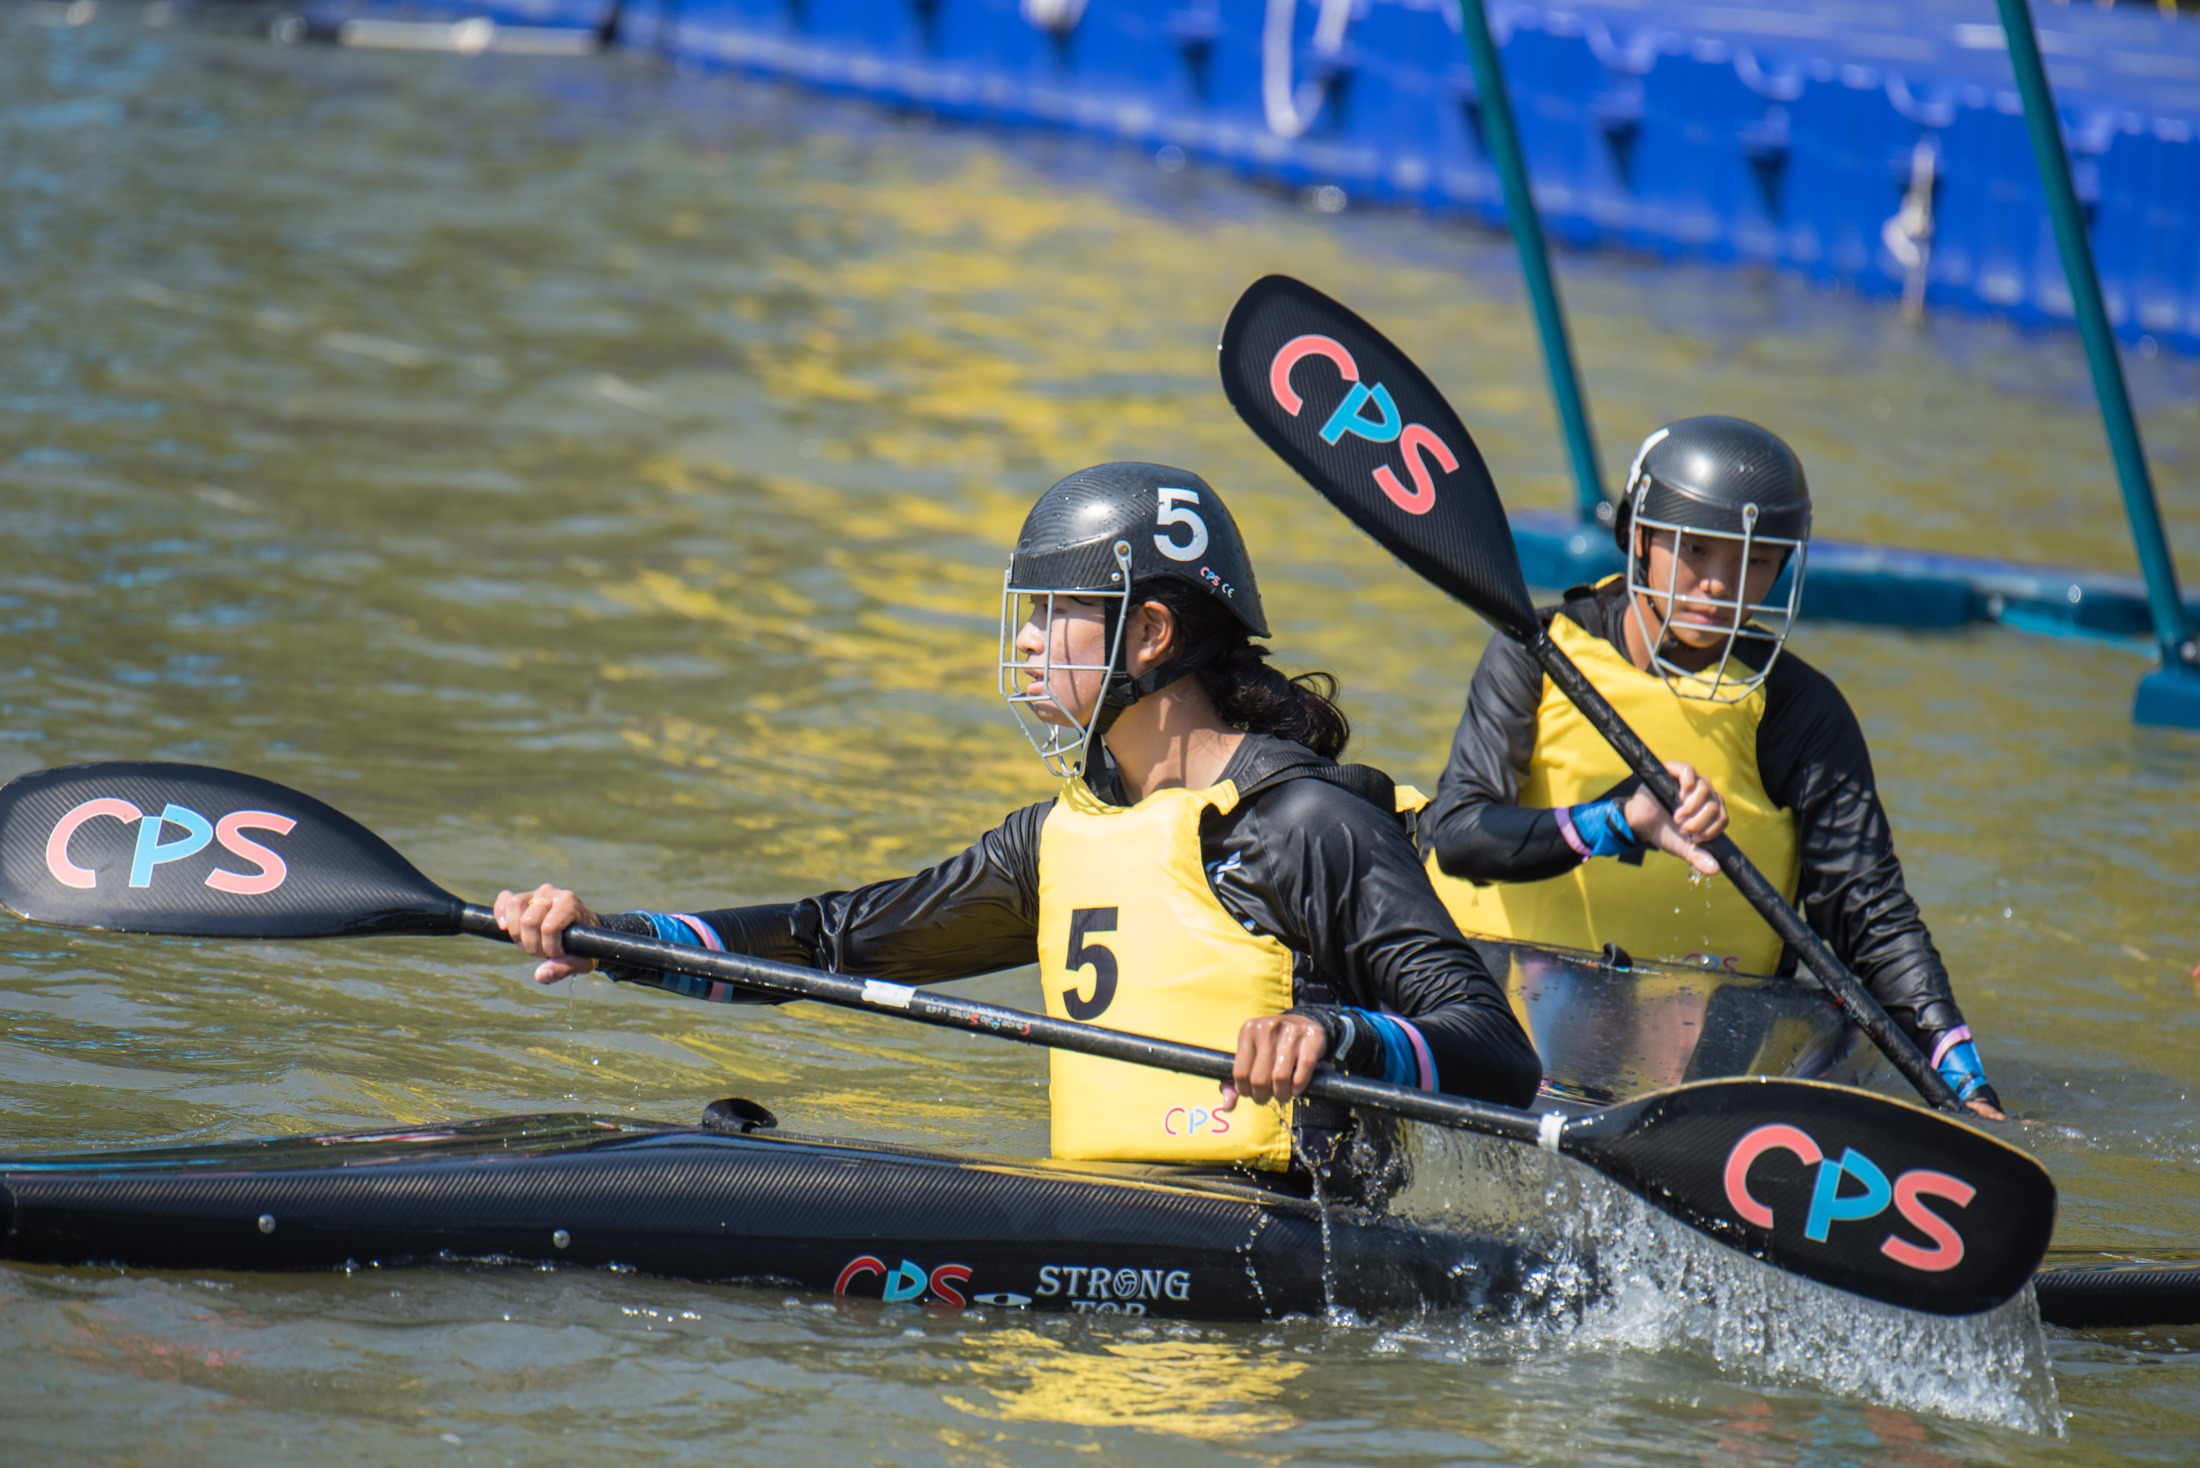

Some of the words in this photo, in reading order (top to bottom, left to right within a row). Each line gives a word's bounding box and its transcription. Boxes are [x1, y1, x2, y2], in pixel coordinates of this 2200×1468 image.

[1270, 334, 1459, 515] CPS
[1153, 487, 1209, 562] 5
[1200, 566, 1221, 587] CPS
[46, 798, 297, 895] CPS
[1062, 906, 1119, 1021] 5
[1163, 1105, 1231, 1136] CPS
[1724, 1123, 1977, 1271] CPS
[834, 1255, 974, 1306] CPS
[1035, 1265, 1191, 1301] STRONG
